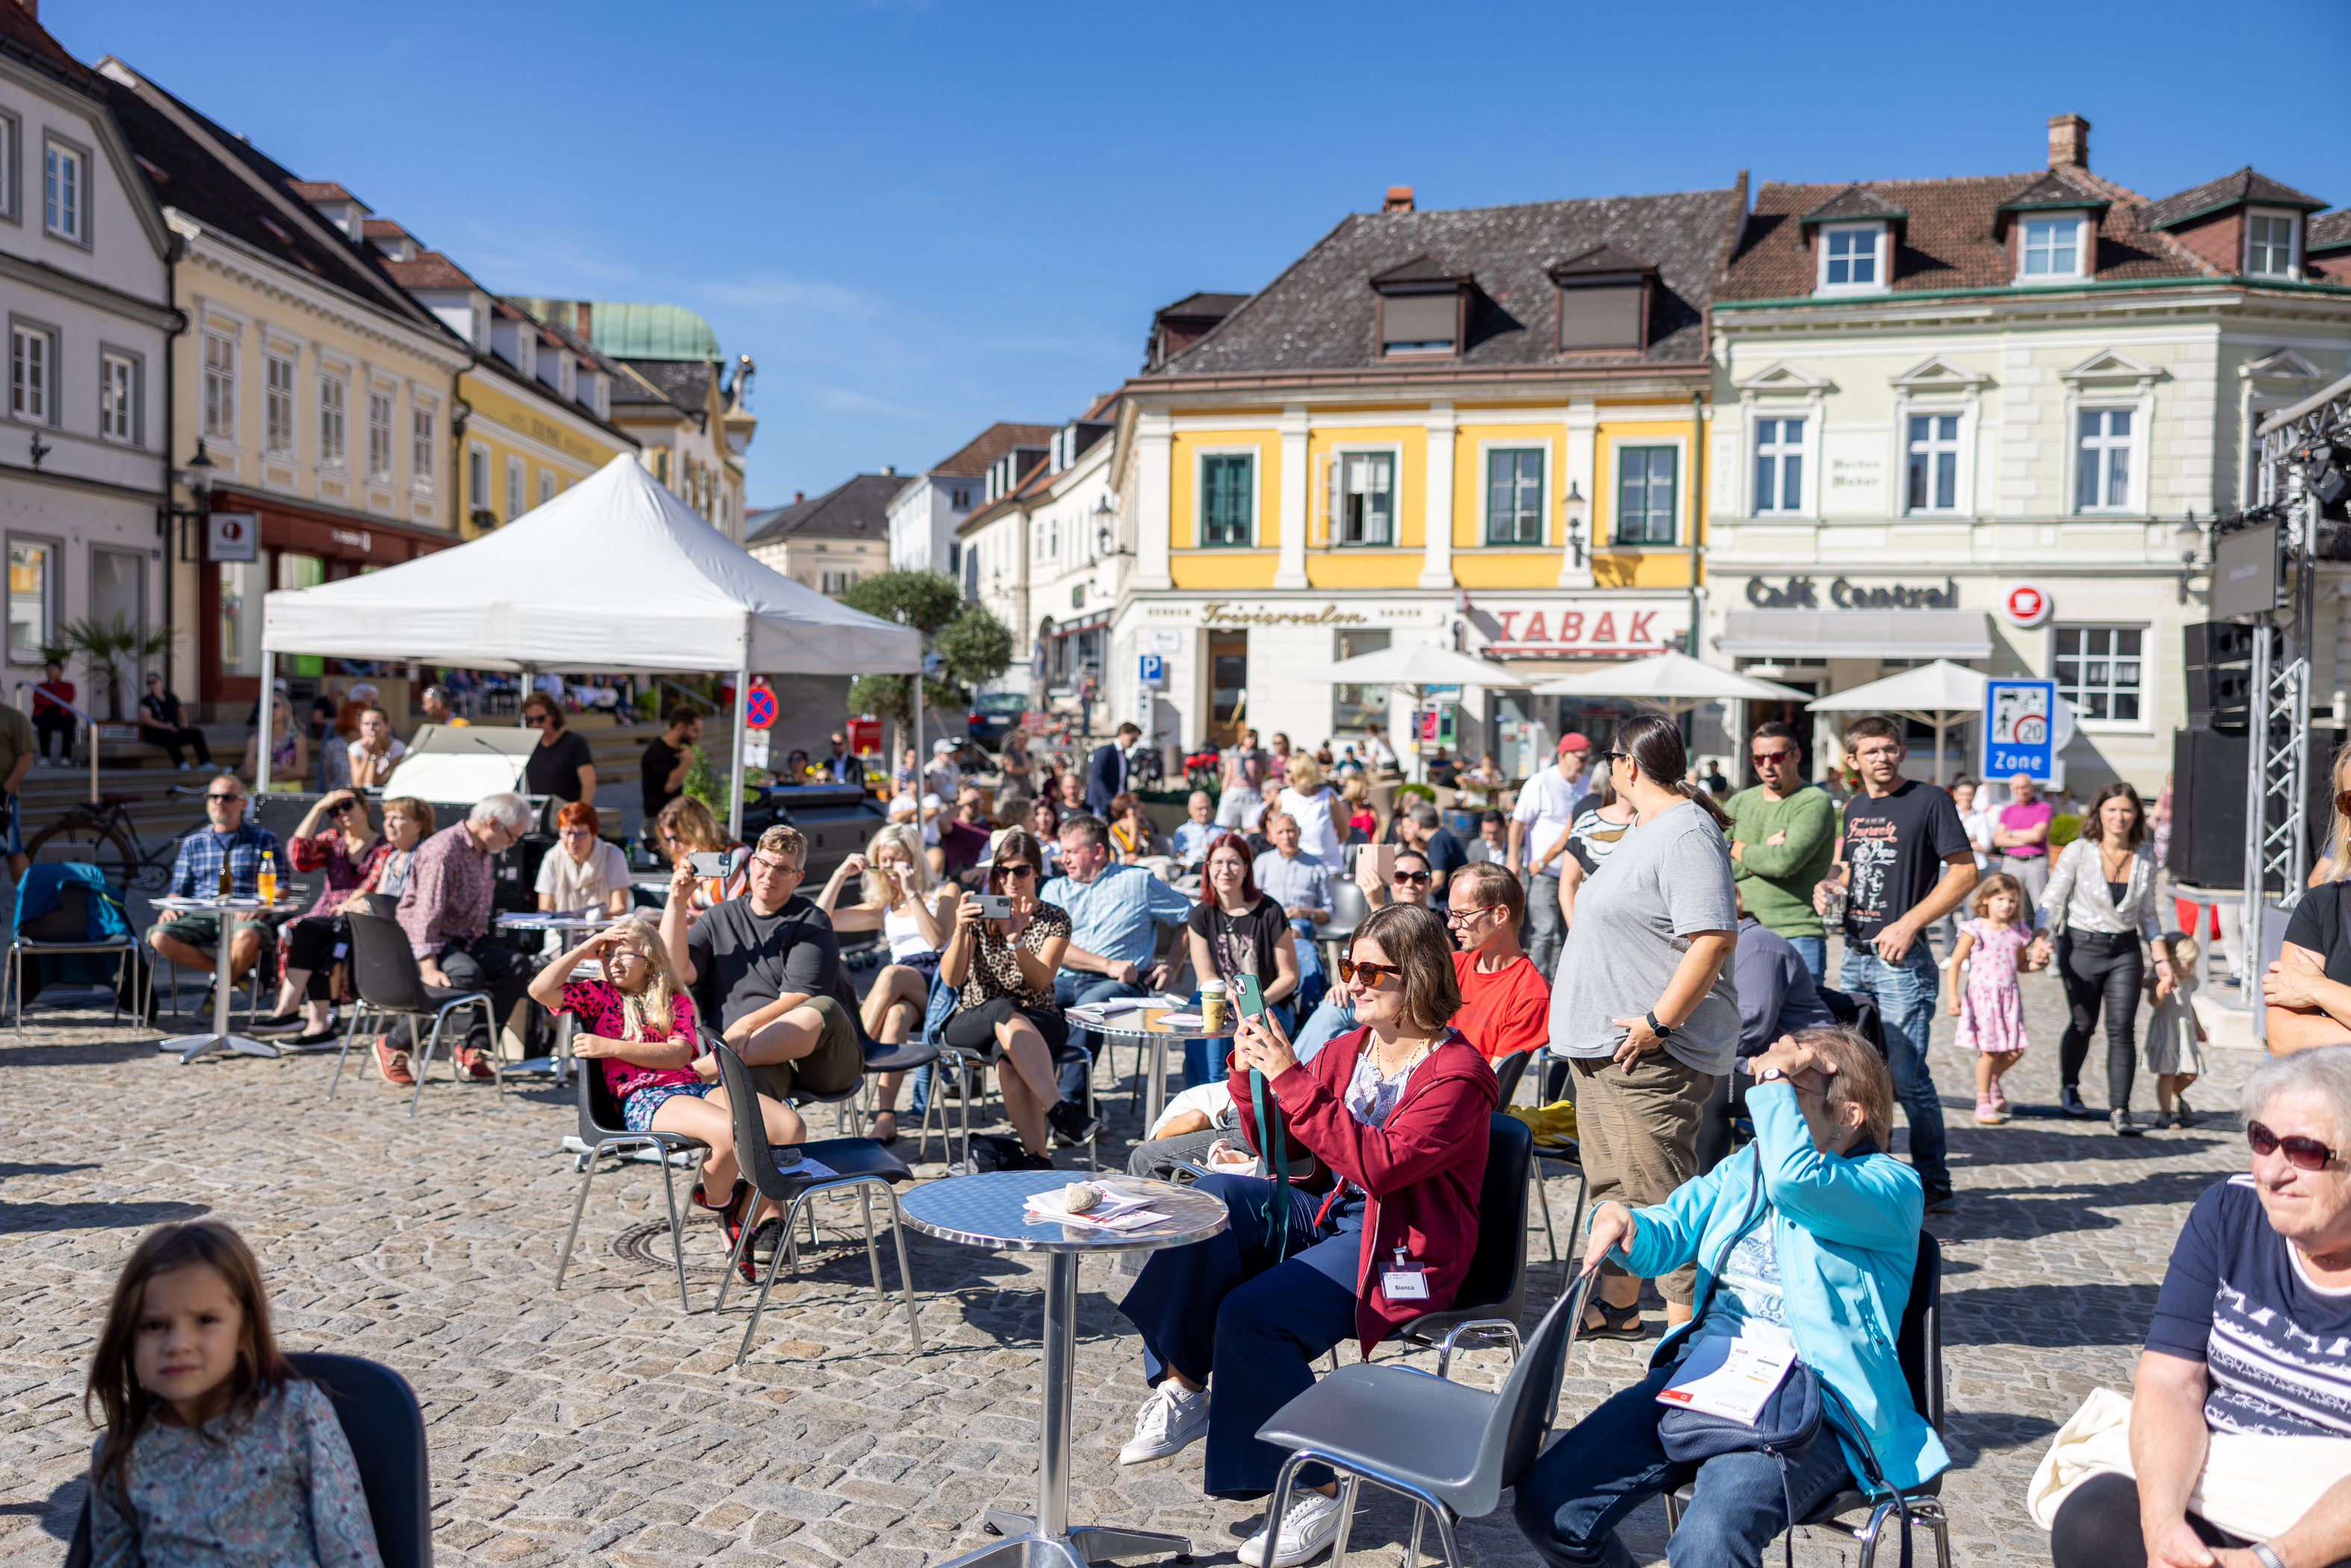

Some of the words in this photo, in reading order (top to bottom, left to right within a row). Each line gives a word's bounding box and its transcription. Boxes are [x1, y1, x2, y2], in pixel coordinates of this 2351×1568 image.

[1831, 577, 1959, 609] Central
[1201, 600, 1367, 624] Frisiersalon
[1498, 611, 1656, 641] TABAK
[1144, 657, 1158, 677] P
[2023, 724, 2043, 741] 20
[1995, 750, 2043, 771] Zone
[1847, 817, 1897, 839] Feuerwehr
[1869, 839, 1898, 861] Papa
